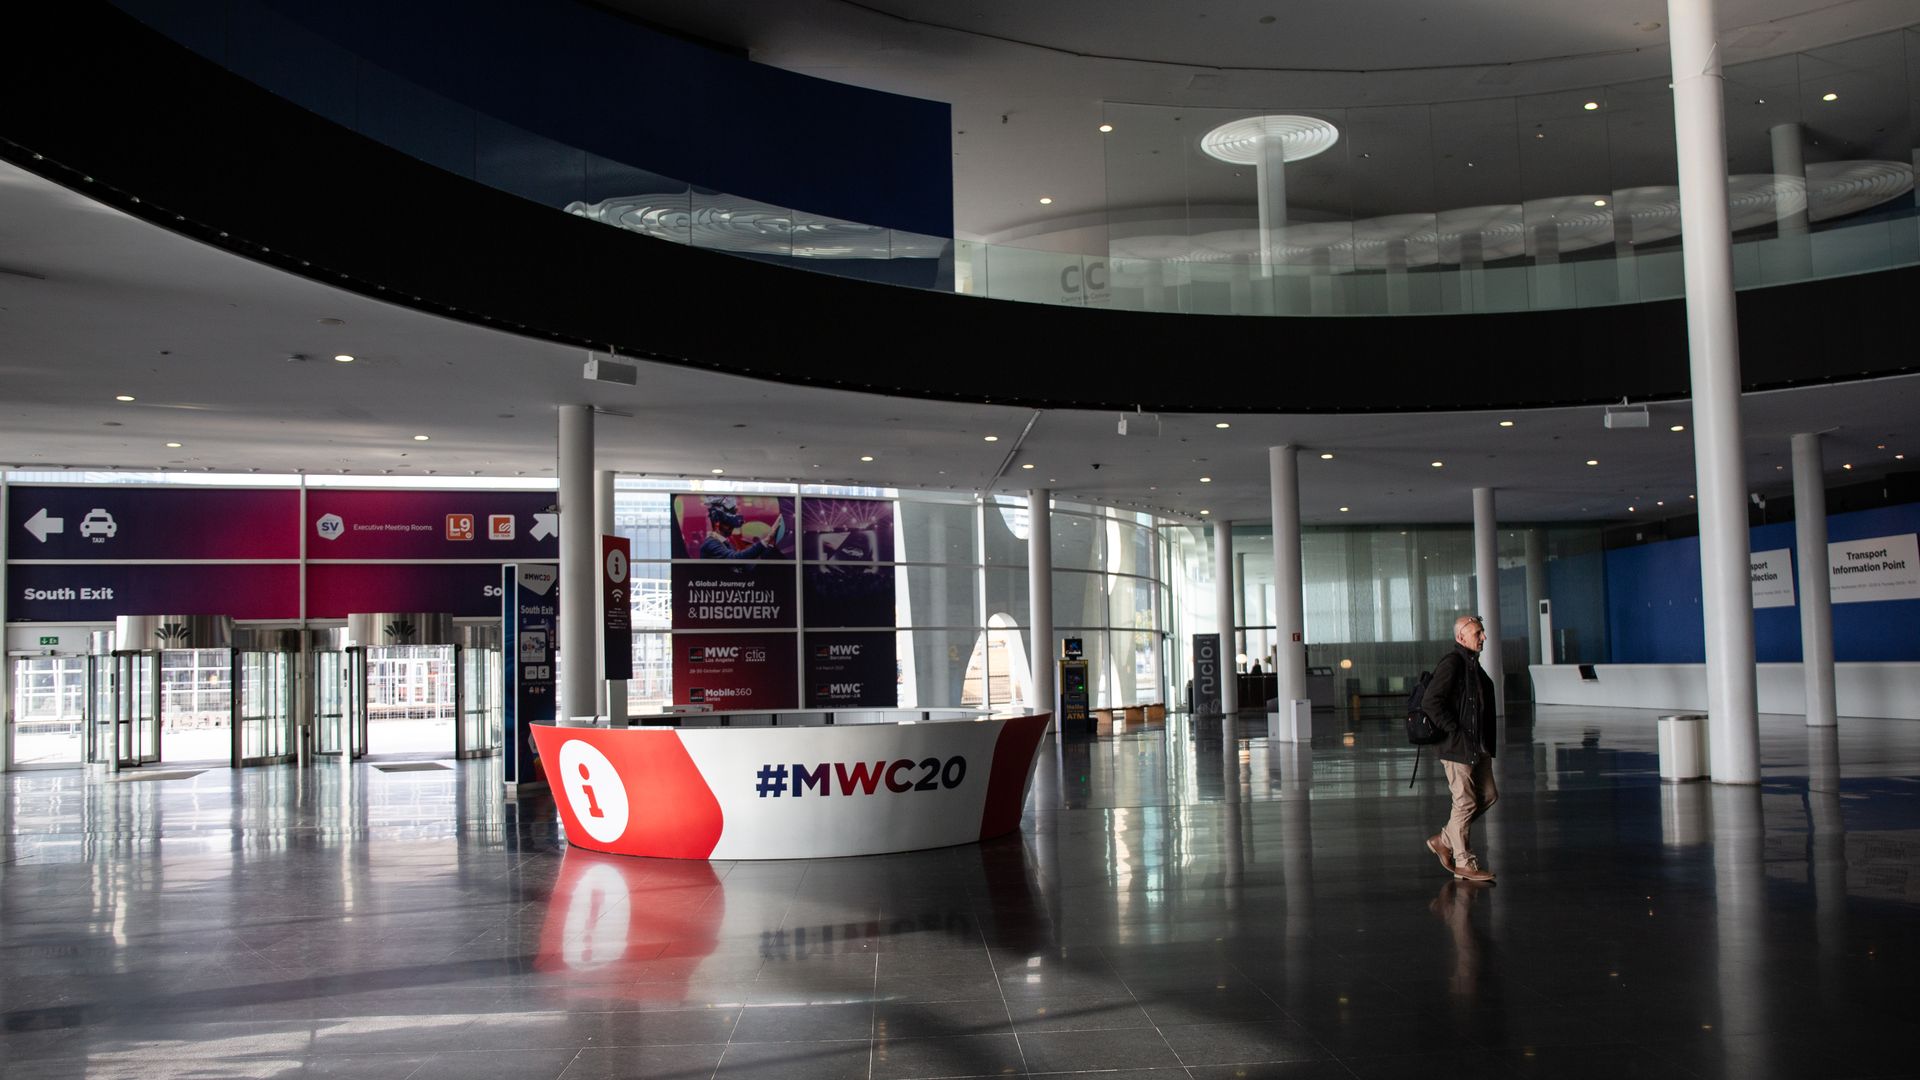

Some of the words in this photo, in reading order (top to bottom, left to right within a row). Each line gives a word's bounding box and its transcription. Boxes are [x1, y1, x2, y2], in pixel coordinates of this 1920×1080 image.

[321, 522, 339, 531] SV
[385, 524, 410, 532] Meeting
[449, 517, 471, 532] L9
[1846, 549, 1887, 561] Transport
[1750, 561, 1768, 571] sport
[1833, 562, 1880, 575] Information
[1882, 560, 1905, 570] Point
[524, 573, 551, 582] #MWC20
[24, 588, 75, 600] South
[80, 588, 114, 600] Exit
[688, 590, 775, 603] INNOVATION
[520, 605, 540, 614] South
[541, 606, 554, 615] Exit
[688, 607, 697, 618] &
[699, 606, 780, 619] DISCOVERY
[705, 647, 739, 658] MWC
[745, 649, 766, 659] ctia
[830, 645, 860, 655] MWC
[705, 688, 752, 698] Mobile360
[830, 684, 861, 694] MWC
[755, 755, 967, 798] #MWC20
